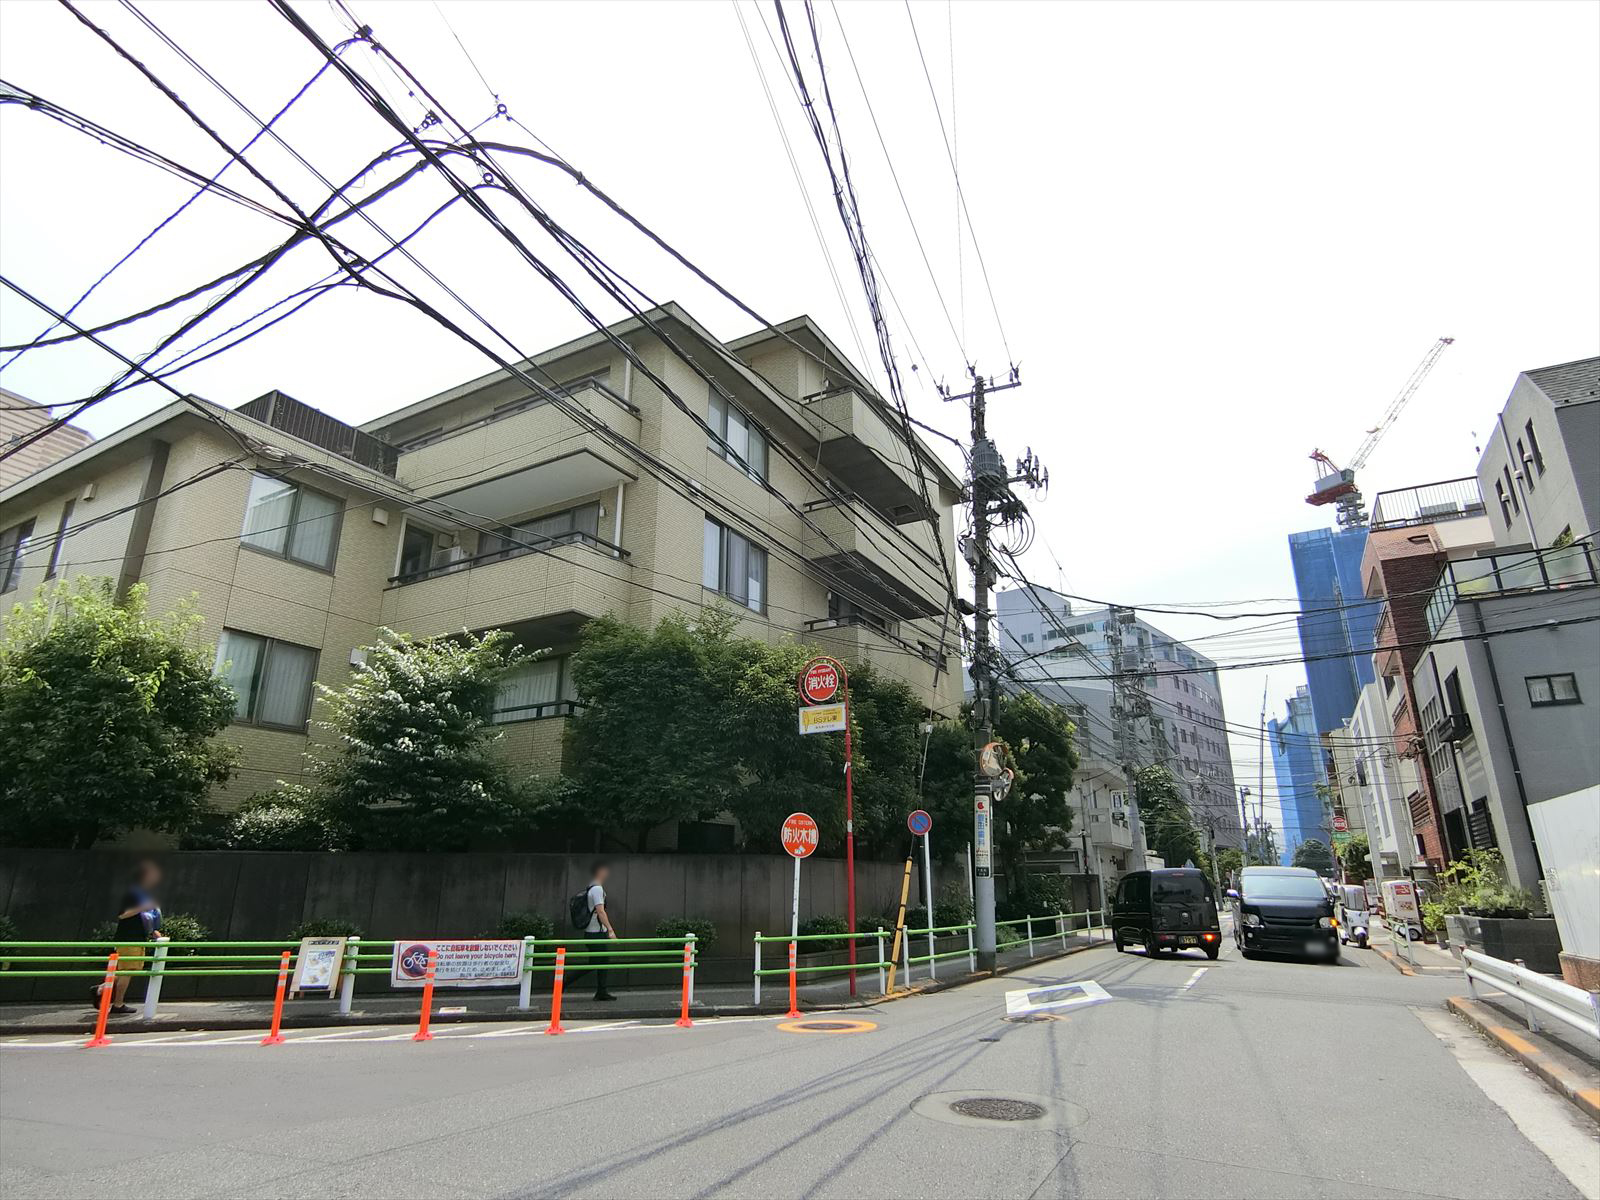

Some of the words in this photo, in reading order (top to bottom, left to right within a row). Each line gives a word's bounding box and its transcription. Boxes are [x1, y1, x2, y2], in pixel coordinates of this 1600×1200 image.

[808, 674, 835, 691] 消火栓
[436, 944, 518, 952] ここに自転車を放置しないでください
[484, 952, 503, 960] bicycle
